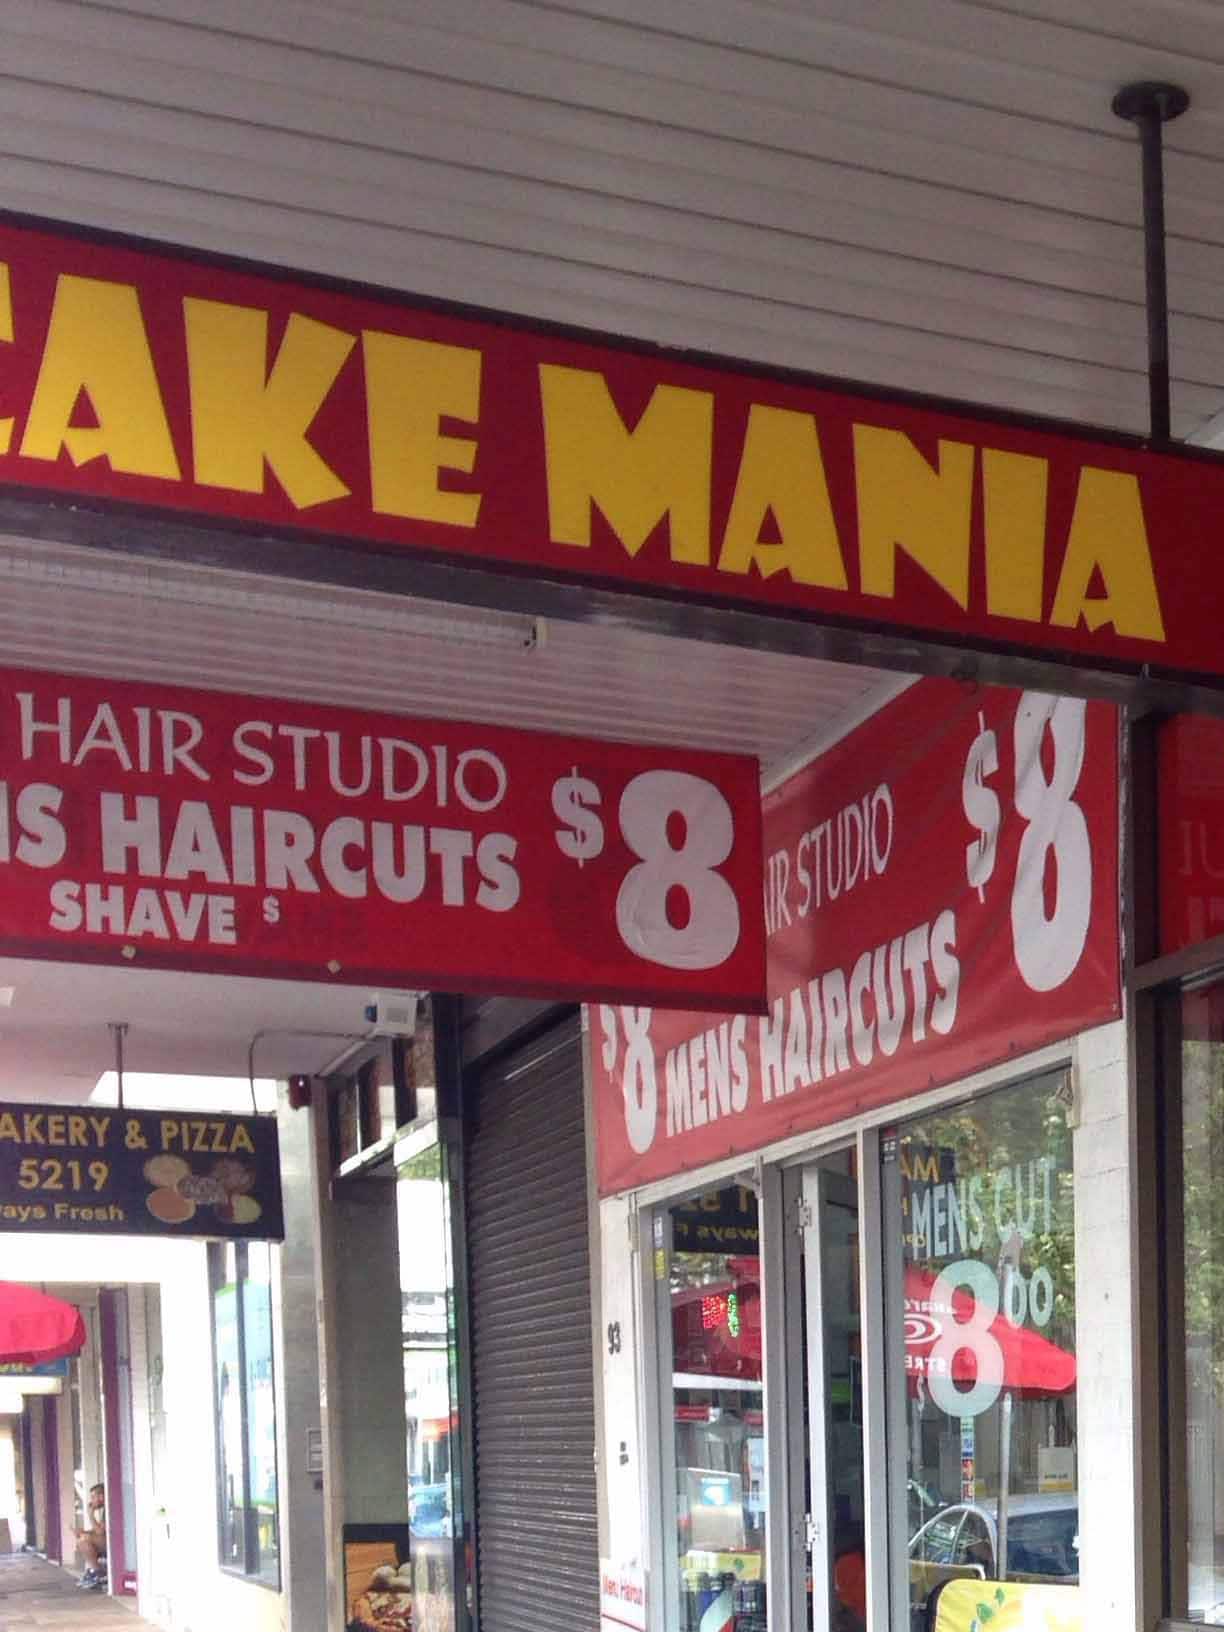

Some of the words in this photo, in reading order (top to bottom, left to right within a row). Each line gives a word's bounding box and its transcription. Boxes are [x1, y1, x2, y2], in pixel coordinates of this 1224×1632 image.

[0, 262, 483, 528] AKE
[538, 363, 1166, 643] MANIA
[16, 692, 208, 781] HAIR
[232, 719, 508, 813] STUDIO
[0, 782, 67, 868] S
[100, 791, 521, 913] HAIRCUTS
[795, 783, 895, 913] STUDIO
[49, 879, 238, 946] SHAVE
[665, 1016, 749, 1138] MENS
[760, 910, 961, 1104] HAIRCUTS
[18, 1157, 112, 1191] 5219
[124, 1119, 149, 1149] &
[160, 1120, 255, 1153] PIZZA
[0, 1203, 47, 1221] ays
[54, 1203, 125, 1223] Fresh
[911, 1172, 984, 1261] MENS
